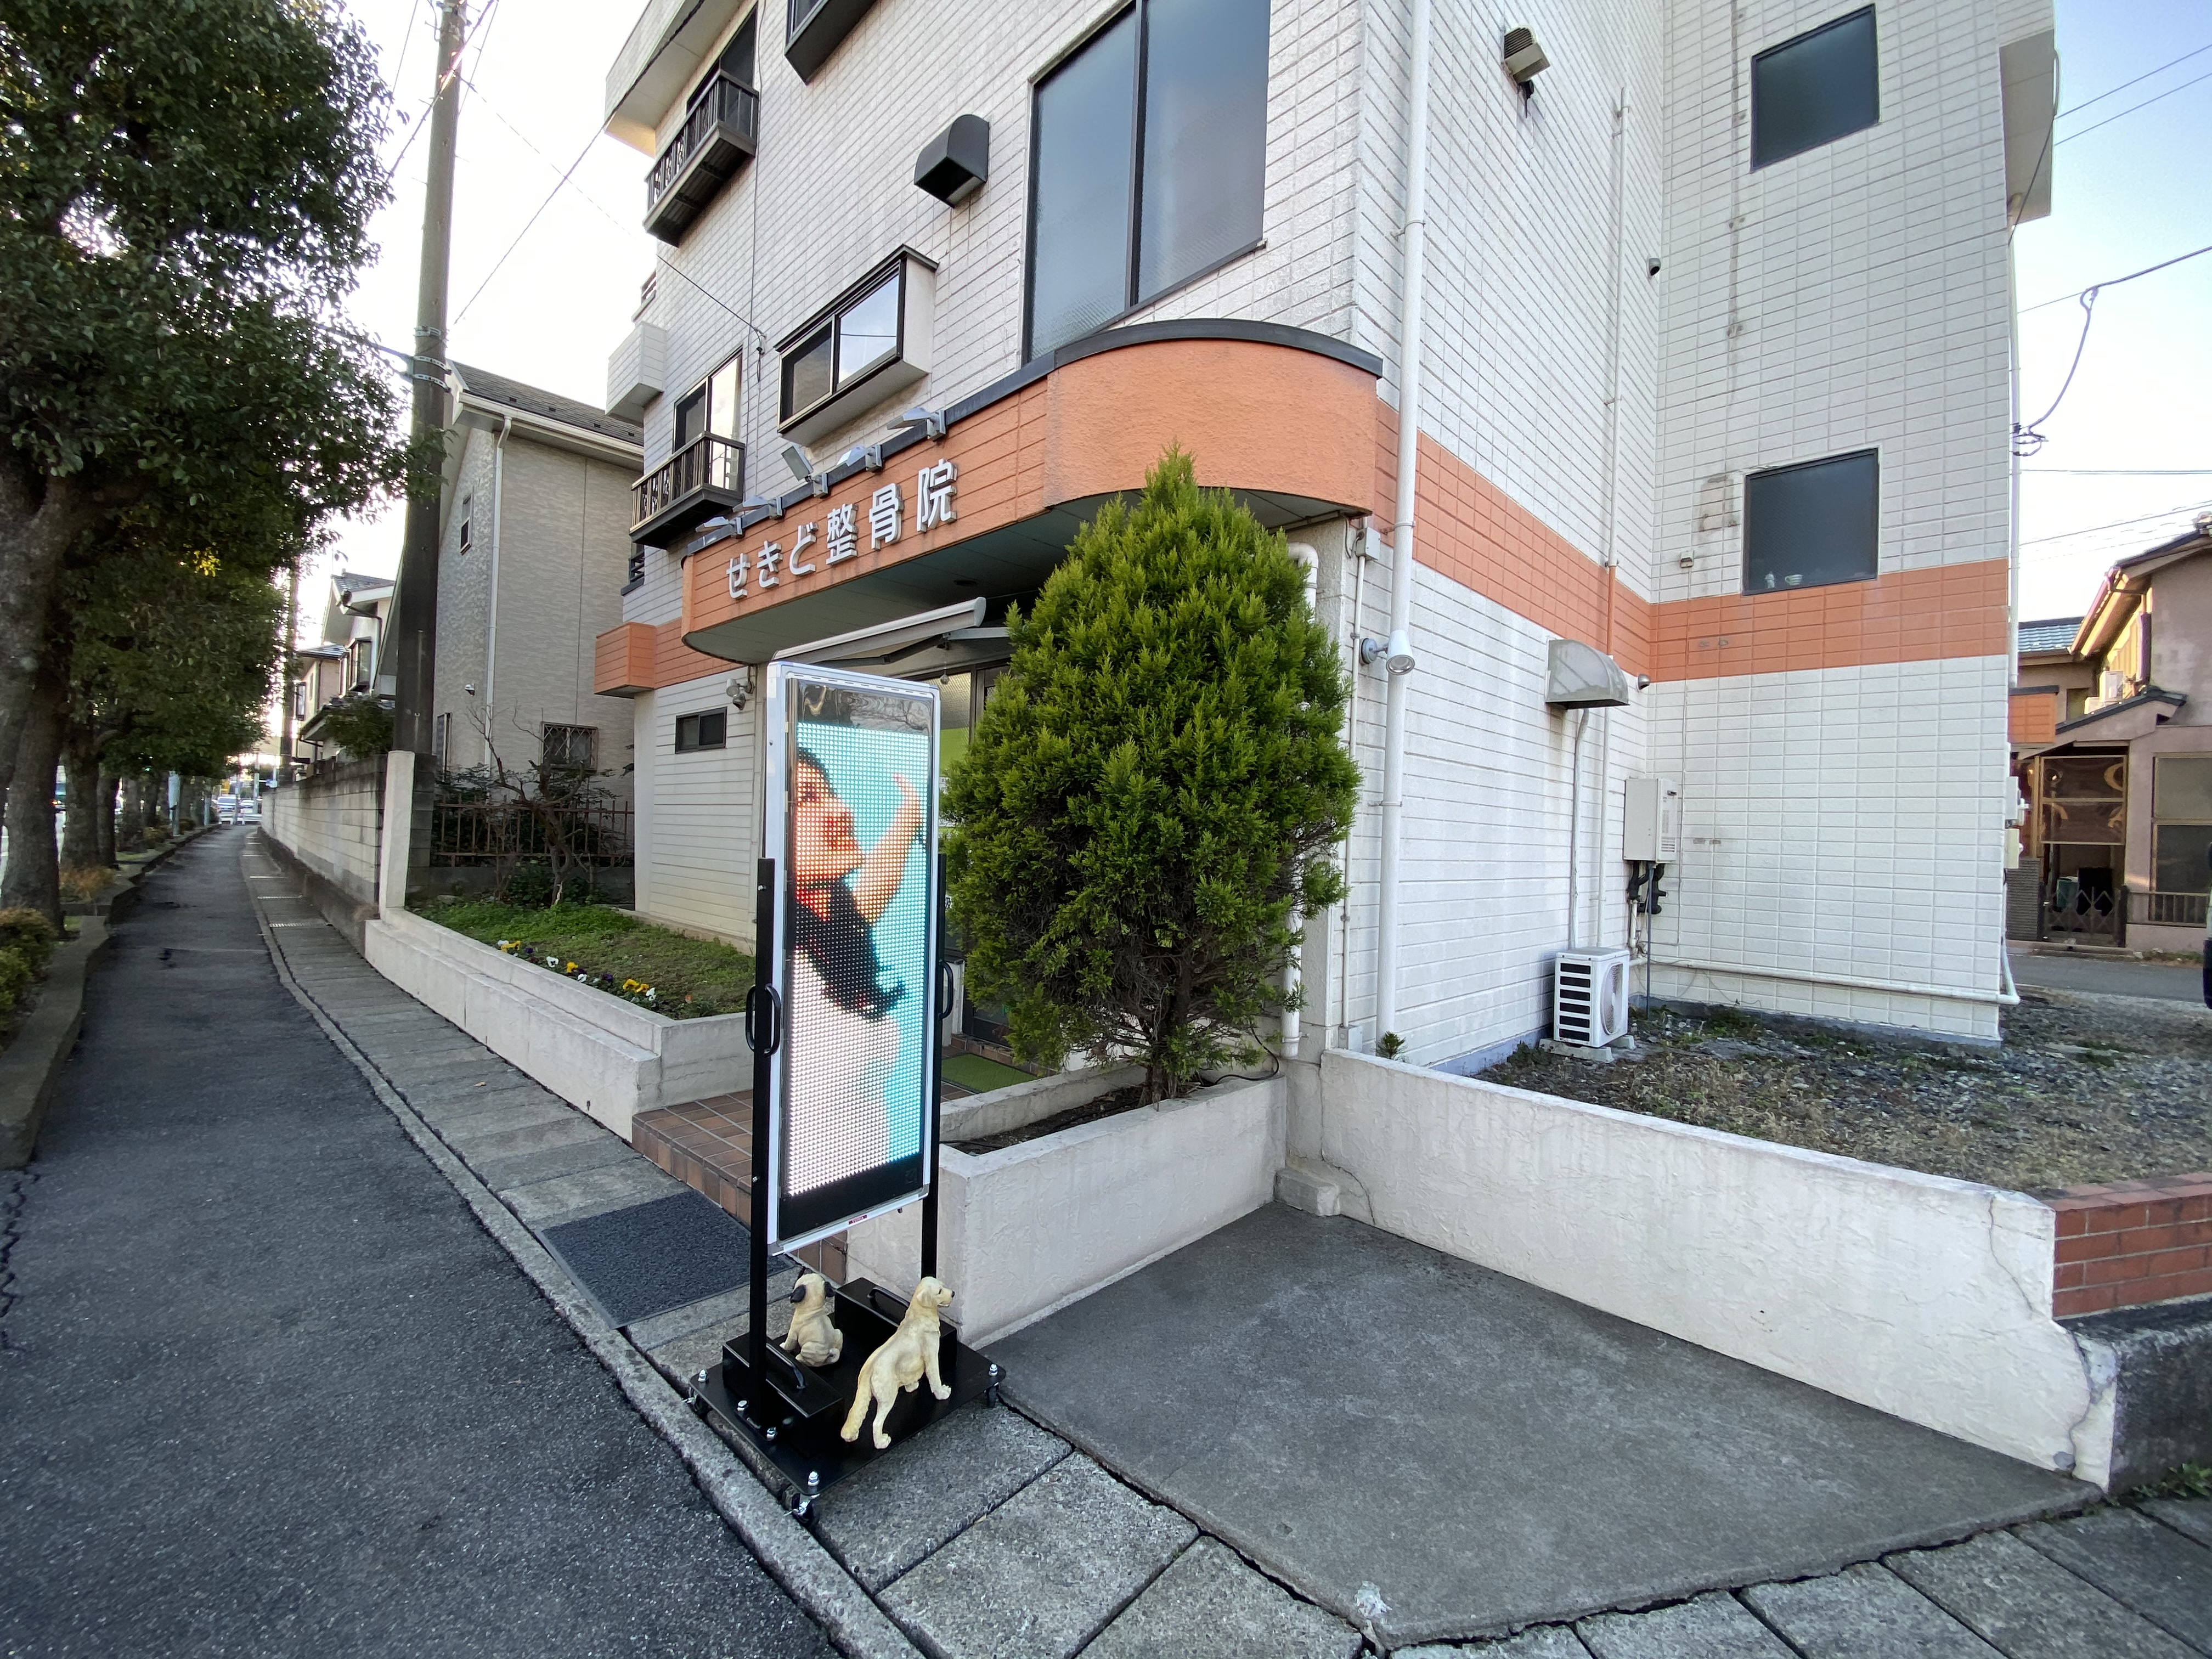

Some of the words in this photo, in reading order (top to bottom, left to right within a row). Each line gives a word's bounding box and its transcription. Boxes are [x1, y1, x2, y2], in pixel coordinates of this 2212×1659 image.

[726, 458, 957, 599] せきど整骨院
